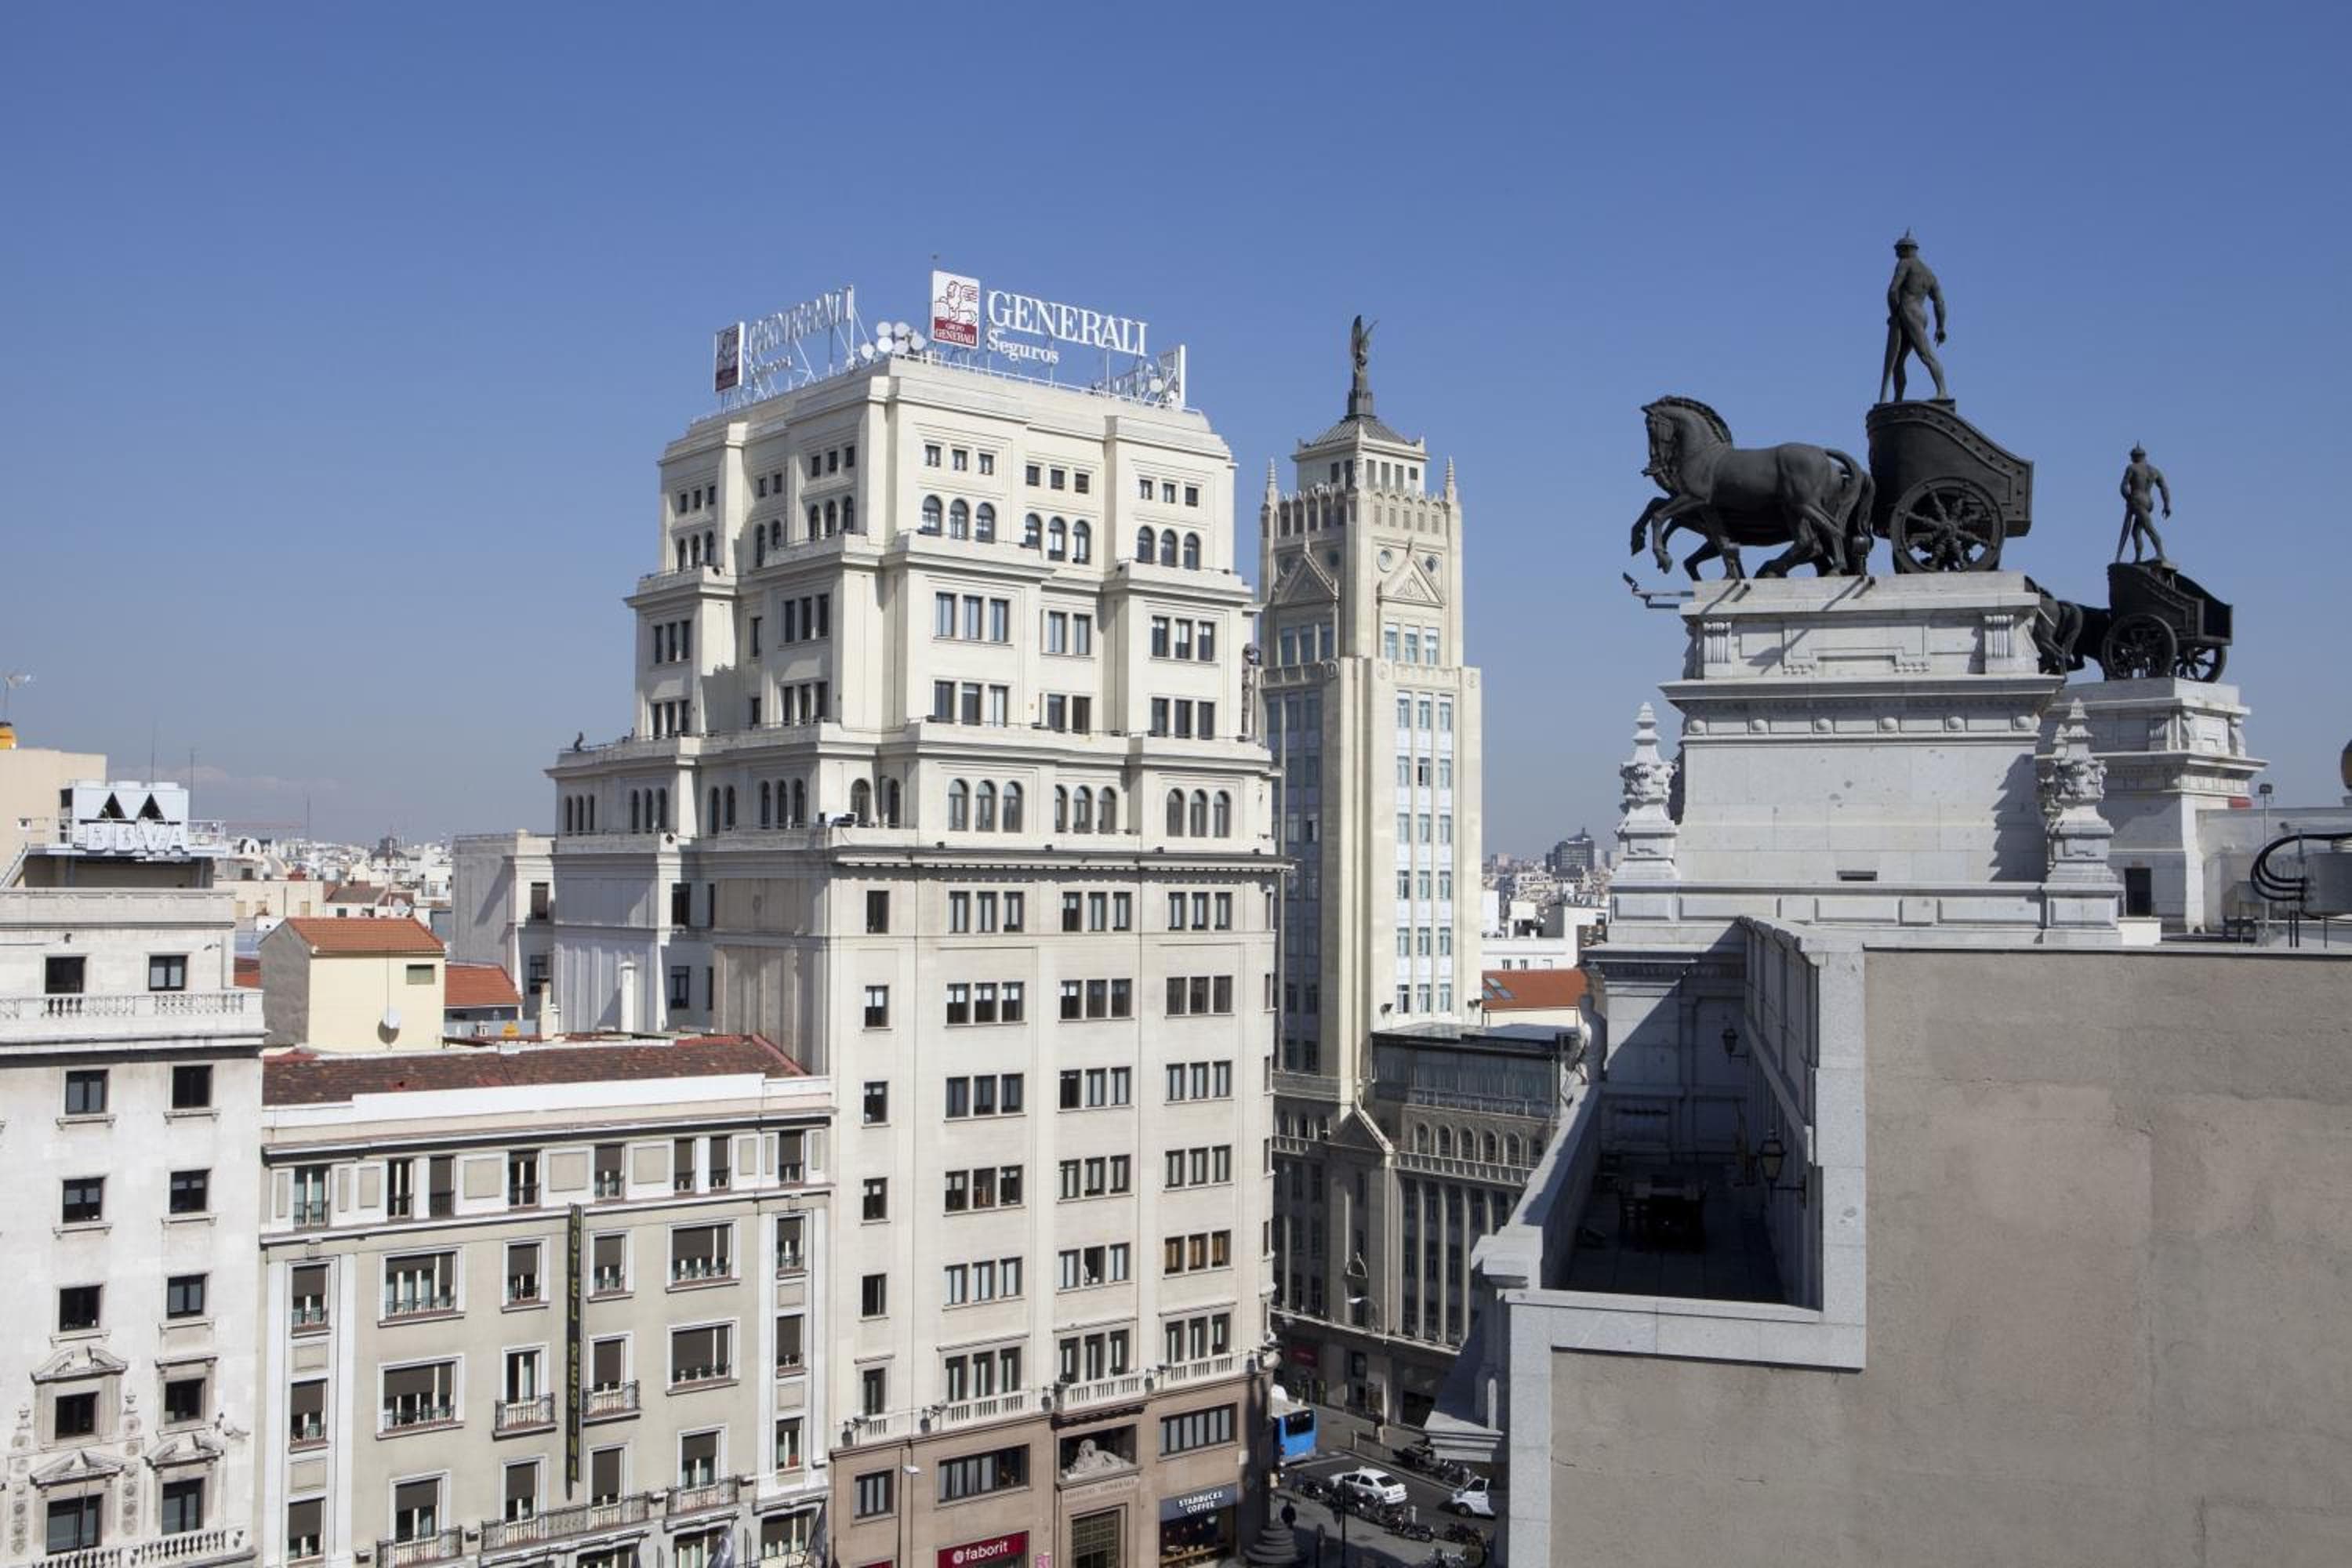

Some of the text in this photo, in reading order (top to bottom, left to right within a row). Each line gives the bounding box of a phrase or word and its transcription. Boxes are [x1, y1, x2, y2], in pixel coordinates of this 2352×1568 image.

[988, 290, 1149, 357] GENERALI
[935, 328, 975, 344] GENERALI
[987, 328, 1059, 365] Seguros
[570, 1207, 580, 1482] HOTEL REGINA
[1178, 1491, 1223, 1508] STARBUCKS
[1187, 1501, 1214, 1514] COFFEE
[965, 1541, 1008, 1561] faborit
